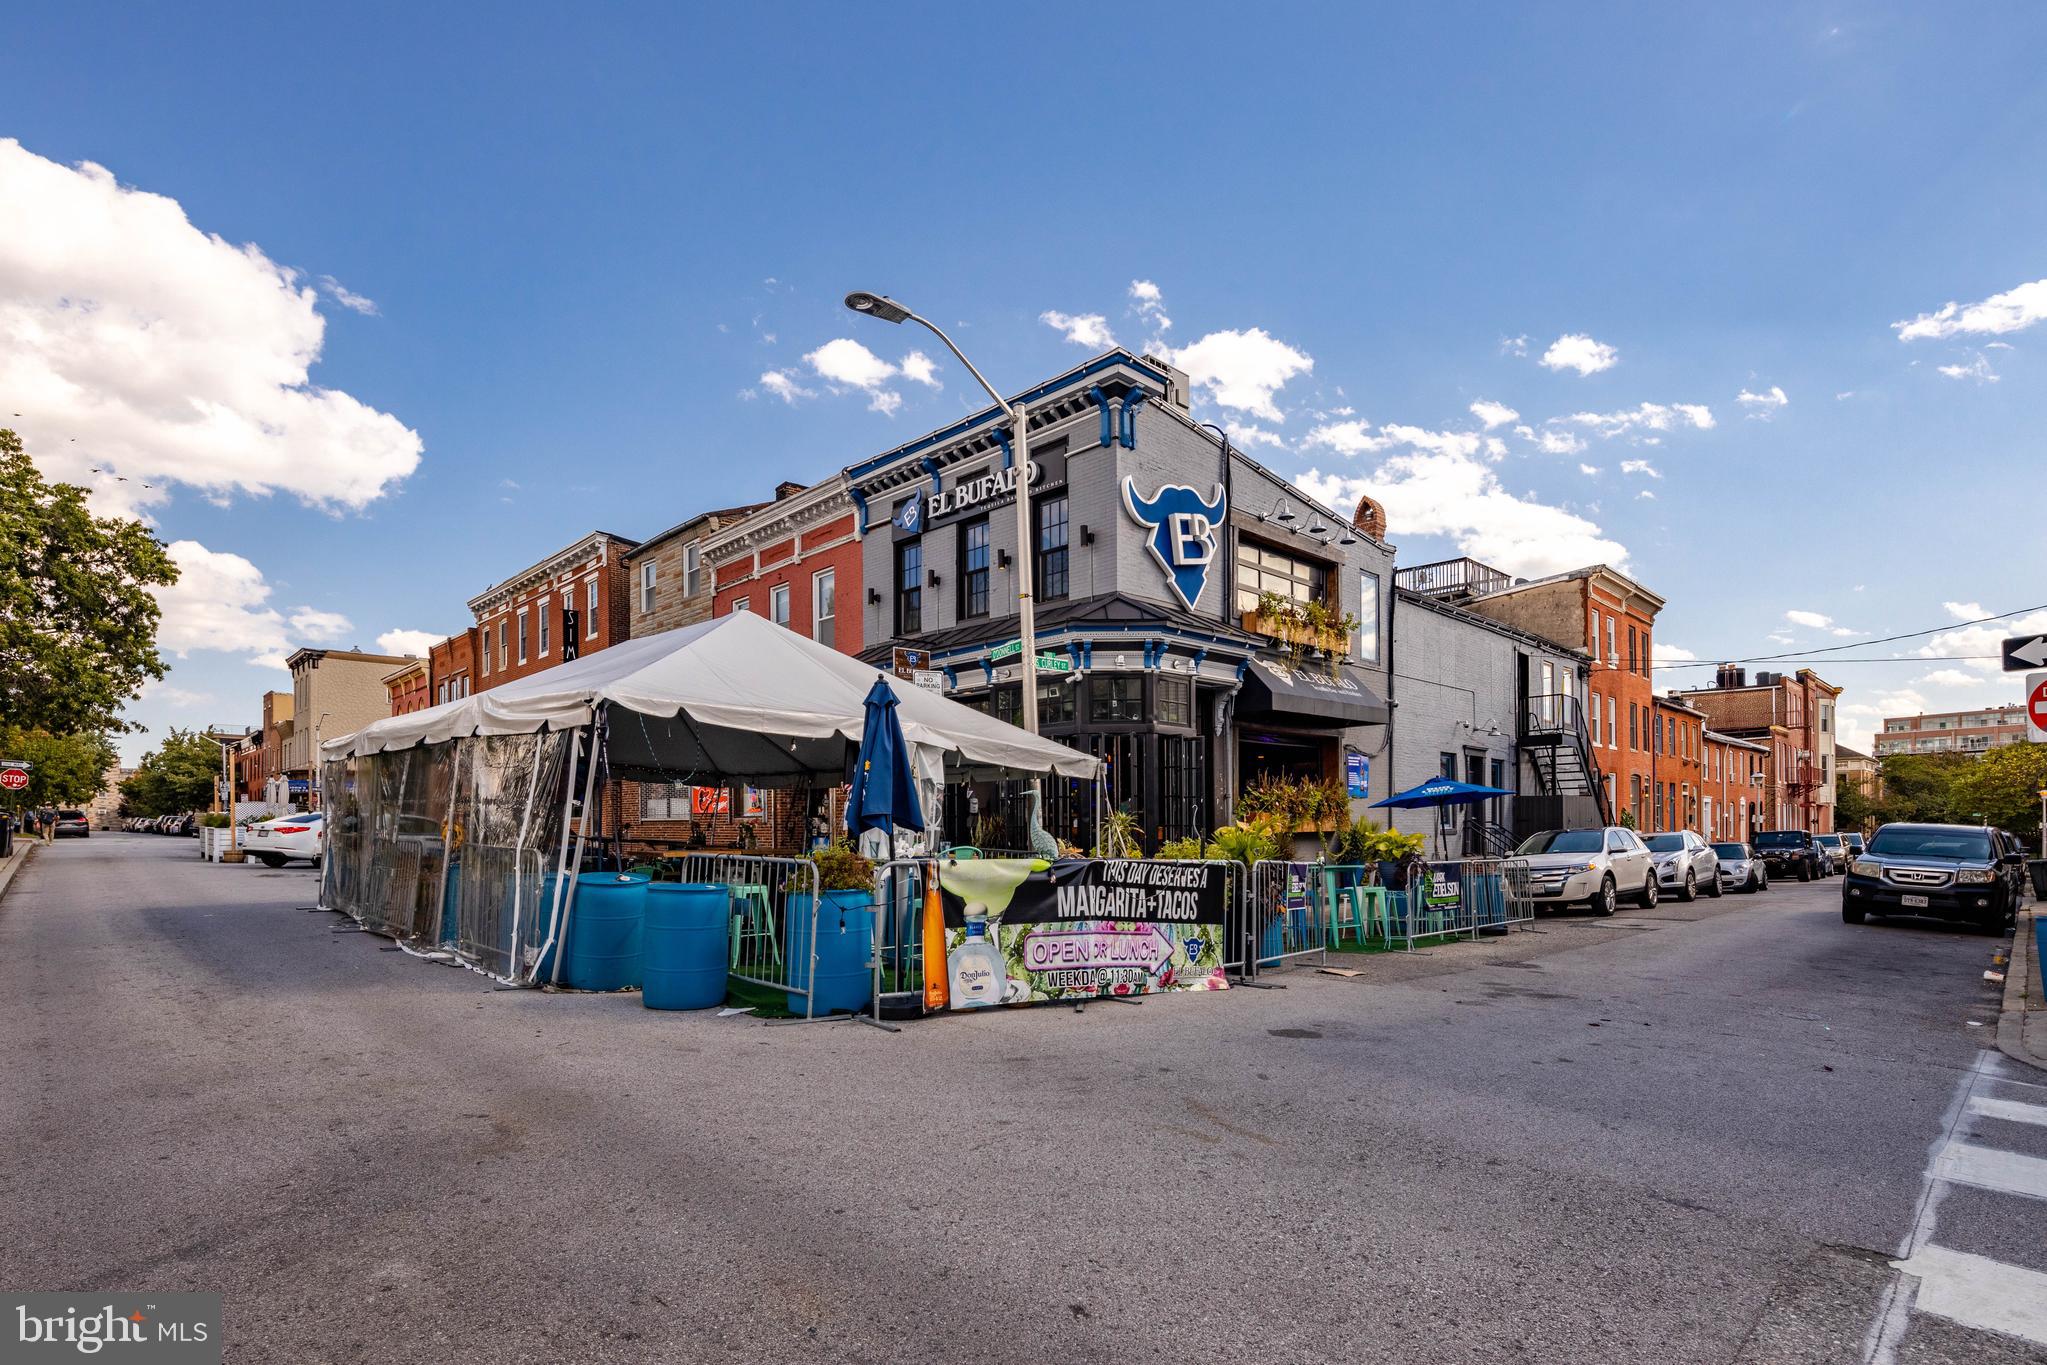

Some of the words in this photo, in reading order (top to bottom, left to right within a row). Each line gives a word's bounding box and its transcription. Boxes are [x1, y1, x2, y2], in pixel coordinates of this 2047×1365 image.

[927, 494, 952, 519] EL
[980, 499, 1004, 511] TEQUILA
[1035, 479, 1063, 492] KITCHEN
[903, 505, 918, 528] EB
[1168, 512, 1214, 566] EB
[1041, 659, 1060, 669] CURLEY
[1292, 669, 1314, 682] EL
[2, 774, 27, 783] STOP
[1103, 860, 1128, 883] THIS
[1126, 862, 1150, 885] DAY
[1150, 864, 1200, 888] DESERVES
[1200, 868, 1208, 889] A
[1032, 939, 1090, 963] OPEN
[1110, 939, 1159, 962] LUNCH
